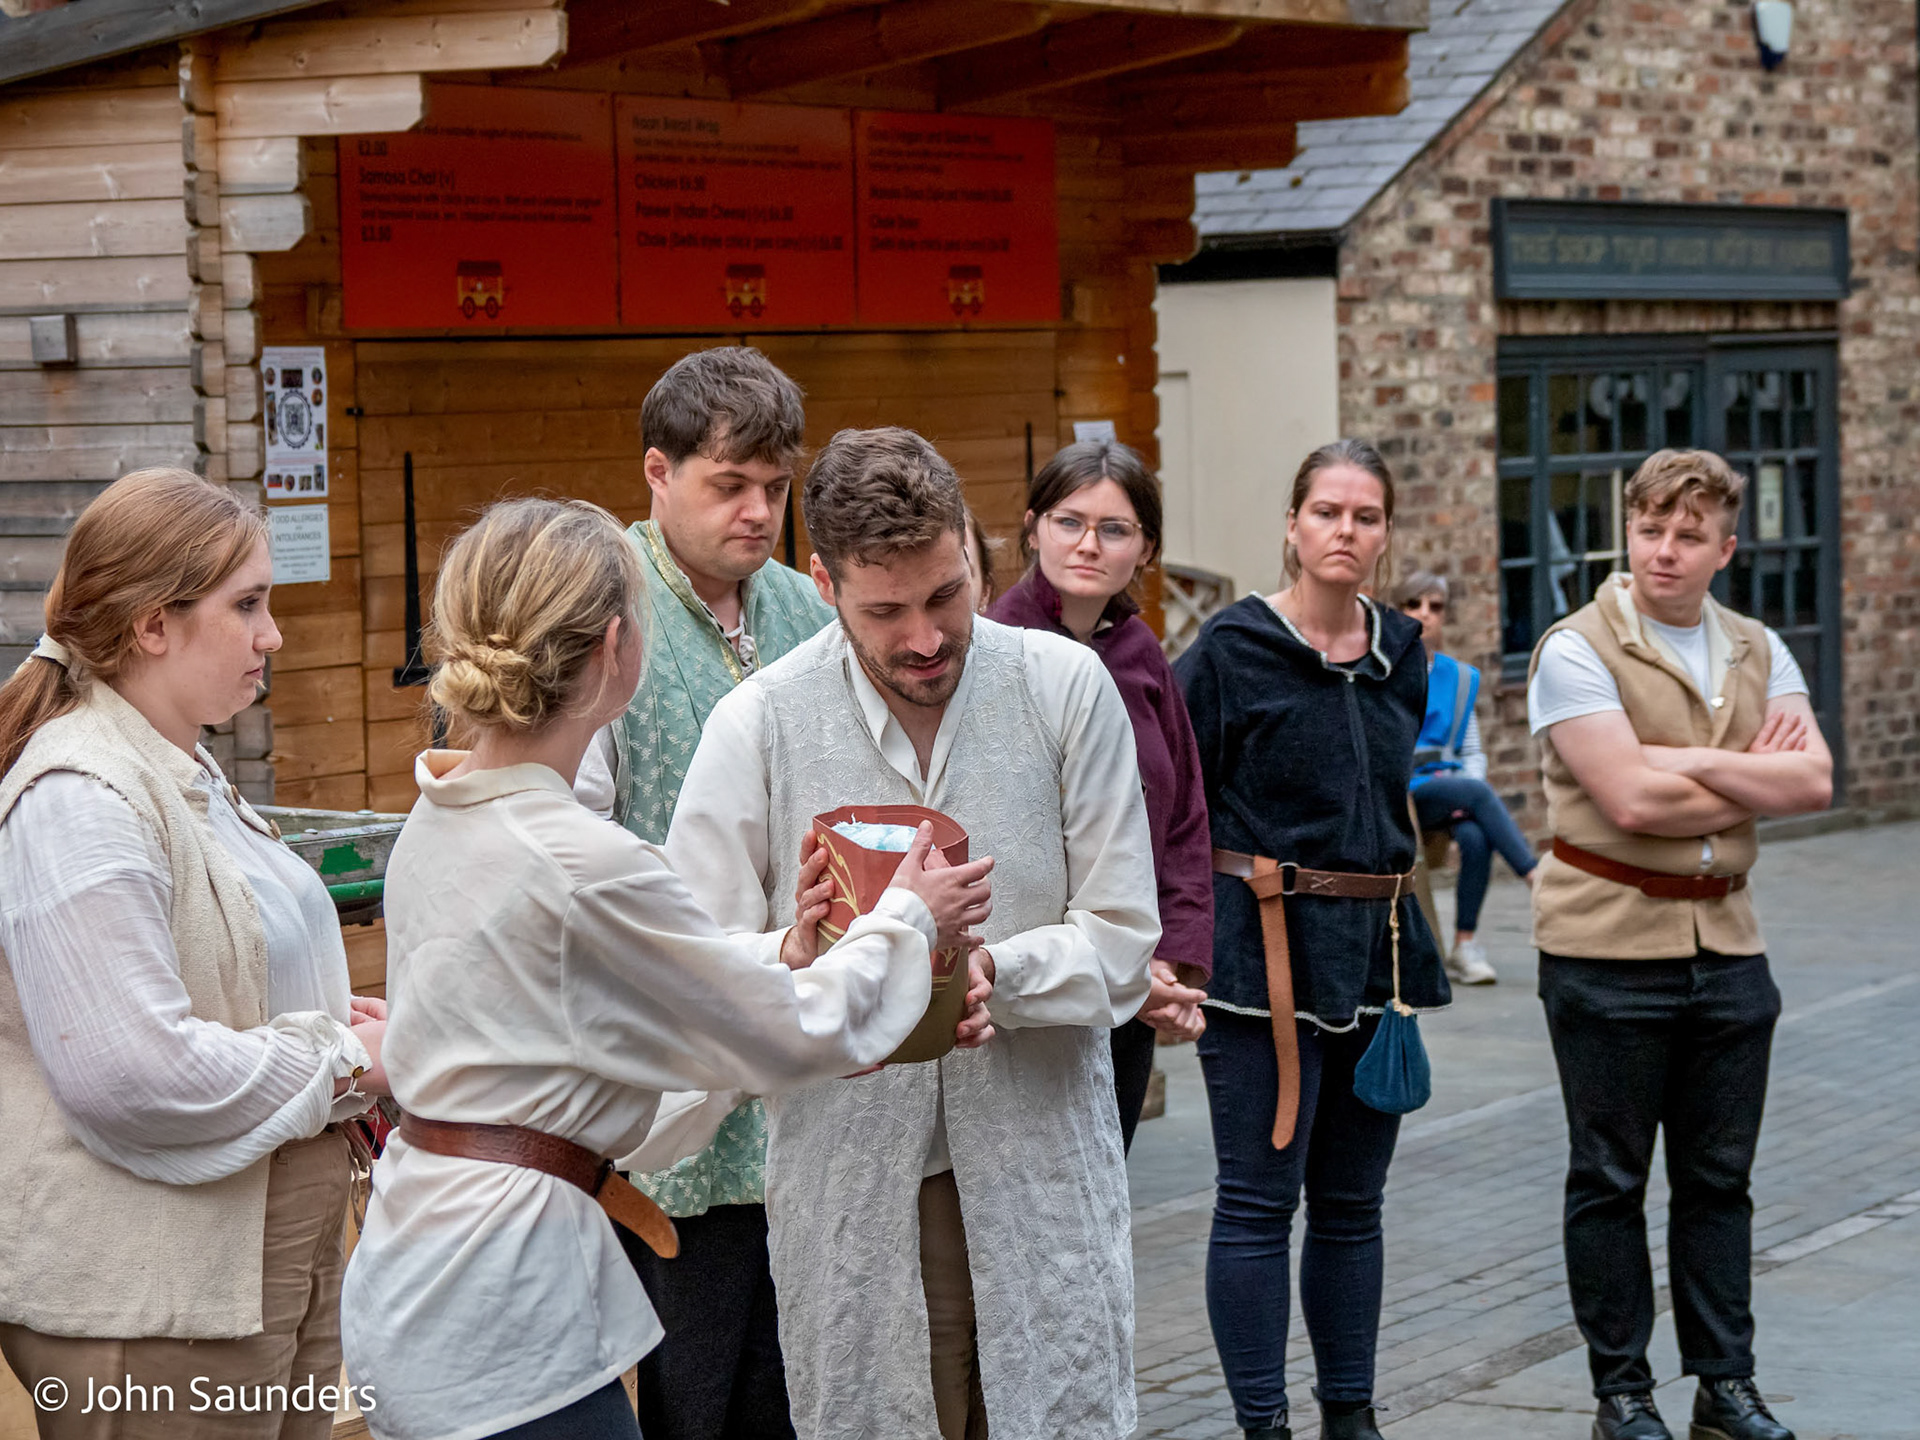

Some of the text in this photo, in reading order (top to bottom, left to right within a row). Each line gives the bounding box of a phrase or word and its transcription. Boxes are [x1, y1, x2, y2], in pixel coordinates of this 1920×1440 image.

[360, 166, 406, 185] Samosa
[635, 173, 677, 190] Chicken
[290, 513, 323, 523] ALLERGIES
[275, 532, 321, 542] INTOLERANCES
